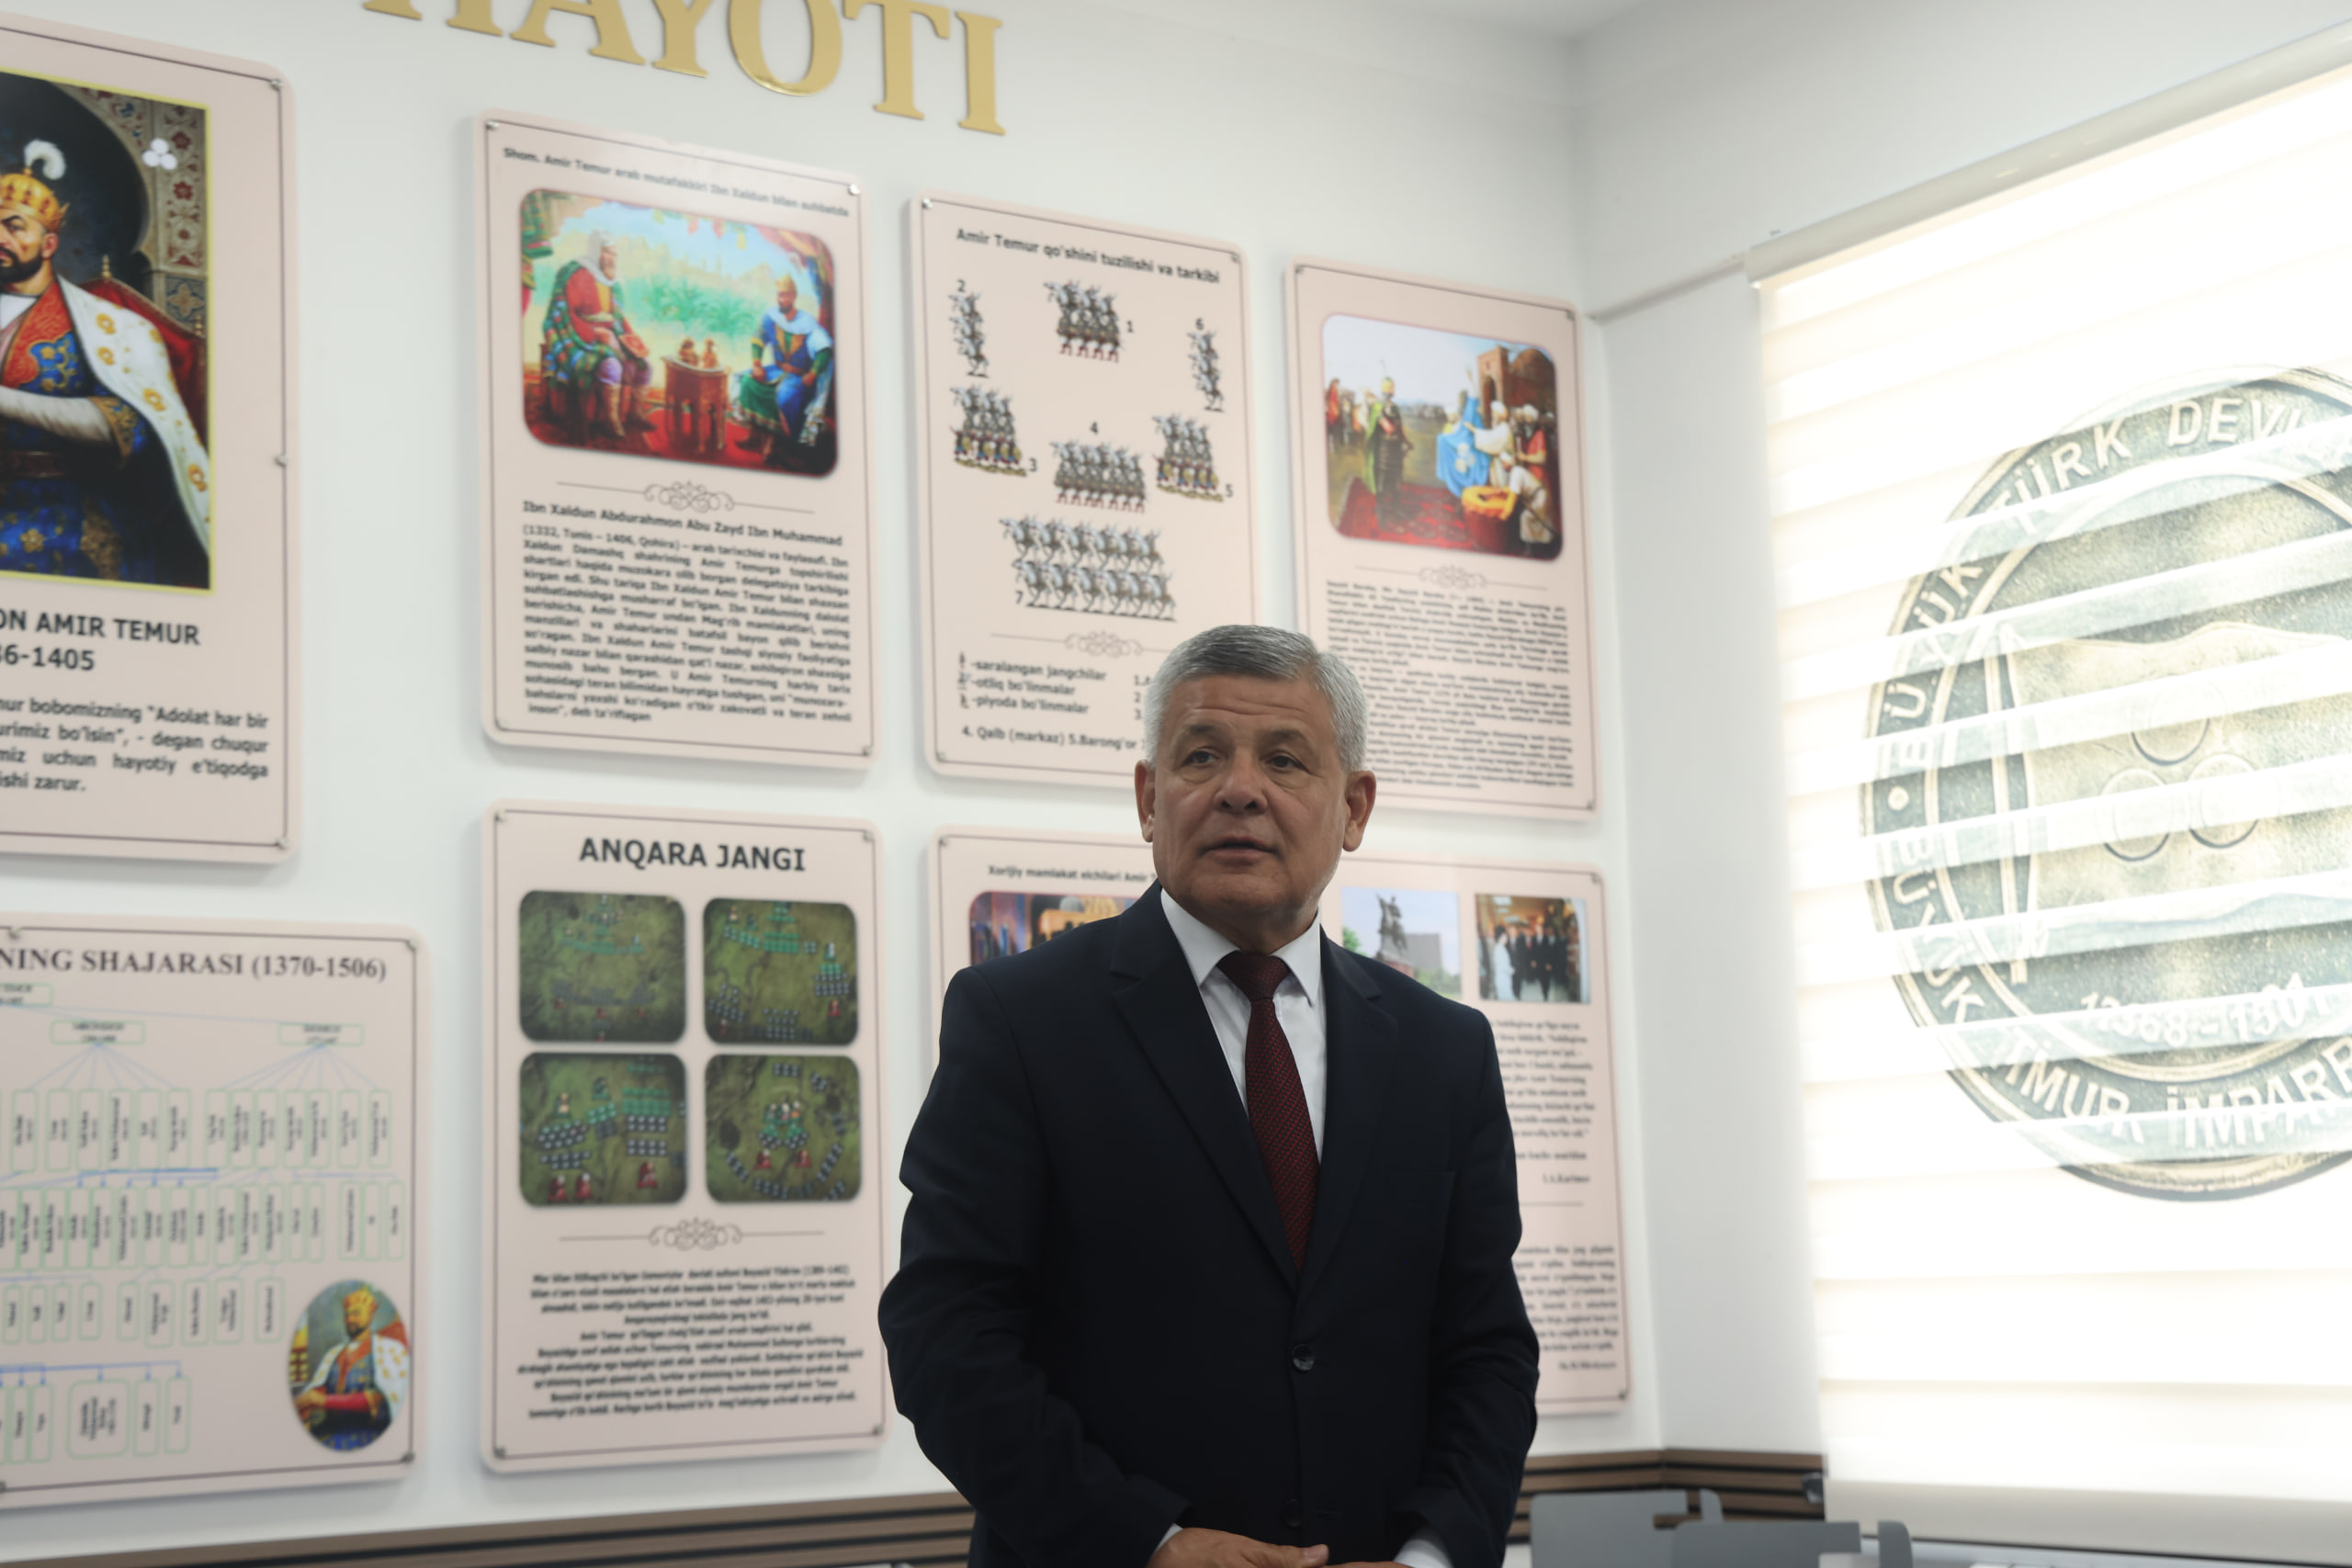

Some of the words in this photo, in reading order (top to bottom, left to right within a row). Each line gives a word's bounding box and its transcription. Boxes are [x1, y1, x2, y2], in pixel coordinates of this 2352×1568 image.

[543, 154, 572, 168] Amir
[573, 158, 613, 175] Temur
[956, 228, 990, 245] Amir
[993, 233, 1040, 254] Temur
[1042, 244, 1098, 264] qo'shini
[1100, 253, 1155, 273] tuzilishi
[1157, 265, 1174, 276] va
[1176, 265, 1220, 284] tarkibi
[957, 279, 967, 293] 2
[1127, 321, 1135, 333] 1
[1195, 319, 1204, 331] 6
[1090, 422, 1099, 434] 4
[1029, 459, 1037, 472] 3
[1226, 485, 1233, 497] 5
[523, 500, 547, 513] Ibn
[550, 503, 597, 519] Xaldun
[599, 509, 684, 528] Abdurahmon
[685, 518, 711, 533] Abu
[714, 521, 745, 536] Zayd
[747, 525, 769, 538] Ibn
[772, 528, 842, 547] Muhammad
[35, 612, 107, 638] AMIR
[112, 617, 200, 646] TEMUR
[28, 697, 142, 725] bobomizning
[214, 710, 243, 728] har
[245, 712, 269, 729] bir
[151, 730, 205, 752] degan
[210, 735, 269, 756] chuqur
[41, 749, 97, 767] uchun
[112, 752, 177, 775] hayotiy
[580, 837, 708, 871] ANQARA
[716, 842, 807, 874] JANGI
[81, 949, 244, 976] SHAJARASI
[251, 953, 388, 984] (1370-1506)
